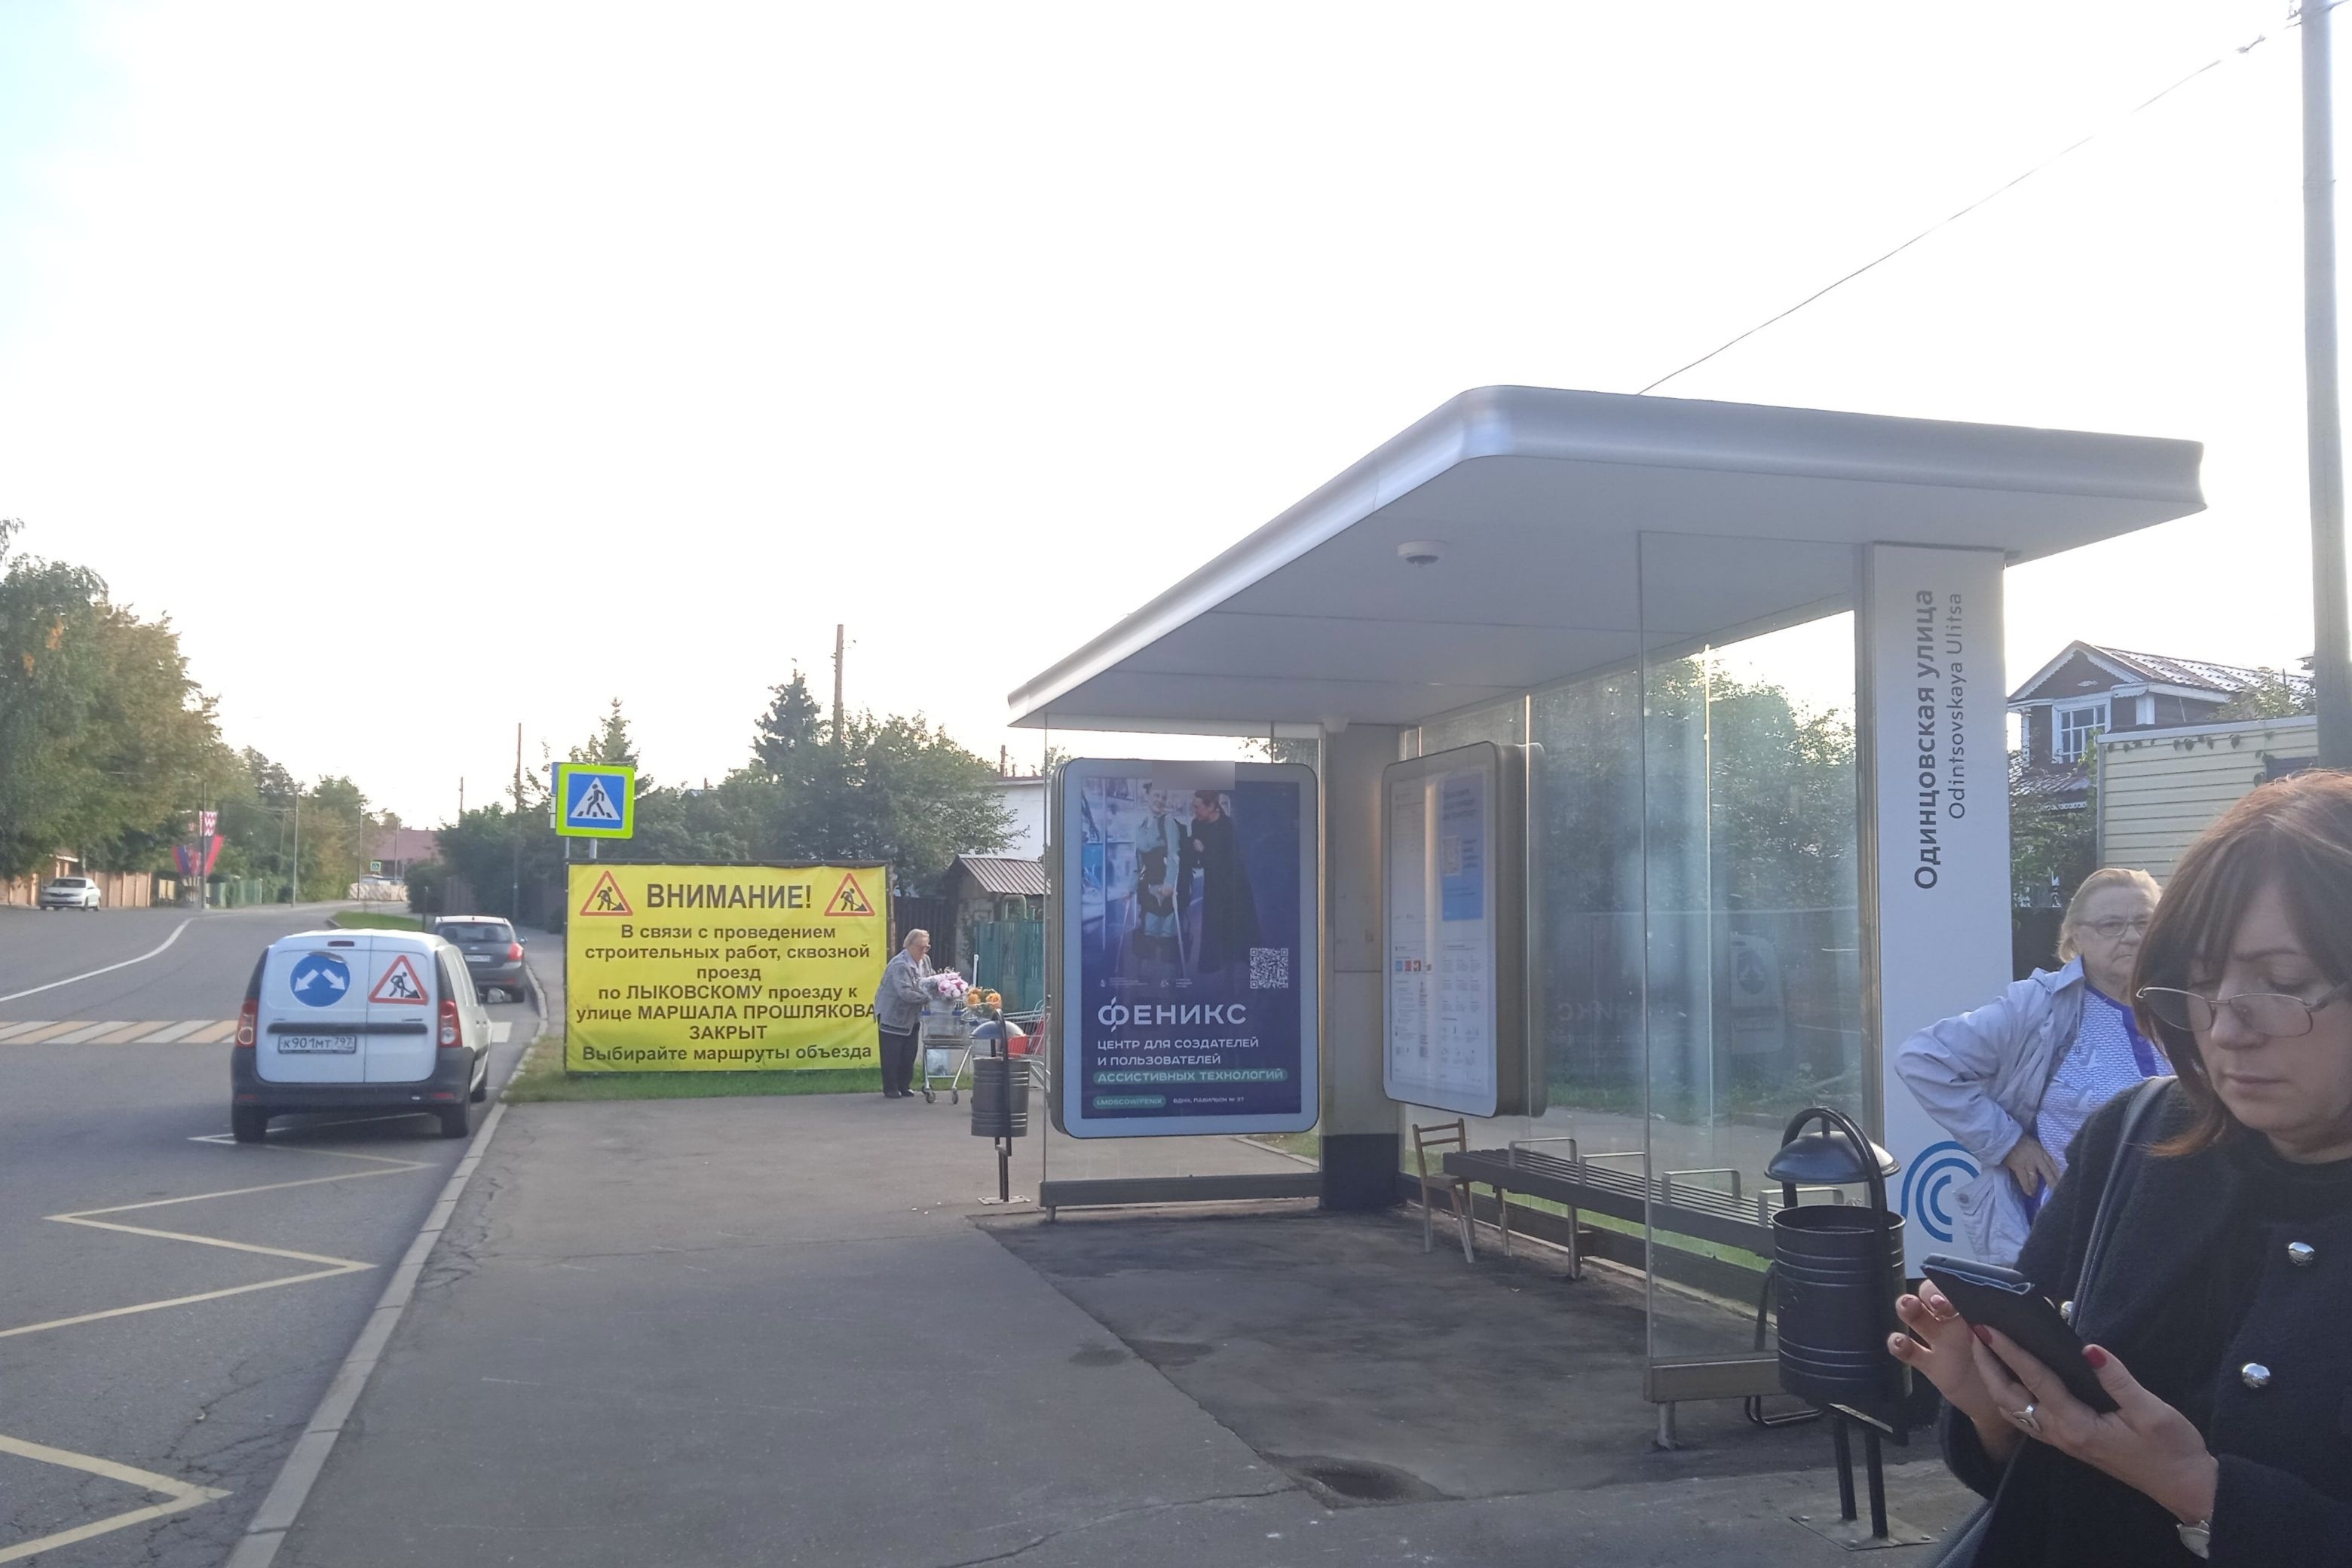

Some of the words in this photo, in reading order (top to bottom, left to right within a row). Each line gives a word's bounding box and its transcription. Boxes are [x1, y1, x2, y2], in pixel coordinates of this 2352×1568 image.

[1946, 593, 1963, 655] Ulitsa
[1916, 590, 1940, 678] улица
[1946, 662, 1967, 819] Odintsovskaya
[1914, 688, 1941, 889] Одинцовская
[647, 884, 812, 908] ВНИМАНИЕ!
[621, 925, 634, 939] В
[640, 927, 692, 939] связи
[698, 928, 708, 939] с
[714, 927, 836, 942] проведением
[585, 948, 719, 962] строительных
[725, 945, 781, 962] работ,
[787, 944, 871, 959] сквозной
[697, 968, 761, 982] проезд
[599, 988, 620, 1000] по
[626, 985, 763, 1000] ЛЫКОВСКОМУ
[769, 988, 843, 1002] проезду
[848, 986, 858, 998] к
[577, 1009, 632, 1024] улице
[638, 1006, 737, 1020] МАРШАЛА
[743, 1004, 874, 1019] ПРОШЛЯКОВА
[1098, 996, 1247, 1033] ФЕНИКС
[689, 1025, 767, 1040] ЗАКРЫТ
[1098, 1040, 1140, 1051] ЦЕНТР
[1144, 1040, 1171, 1050] ДЛЯ
[1174, 1037, 1259, 1049] СОЗДАТЕЛЕЙ
[583, 1046, 688, 1061] Выбирайте
[693, 1047, 790, 1064] маршруты
[796, 1045, 871, 1059] объезда
[1098, 1057, 1107, 1065] И
[1110, 1054, 1220, 1065] ПОЛЬЗОВАТЕЛЕЙ
[1098, 1071, 1196, 1082] АССИСТИВНЫХ
[1200, 1069, 1283, 1080] ТЕХНОЛОГИЙ
